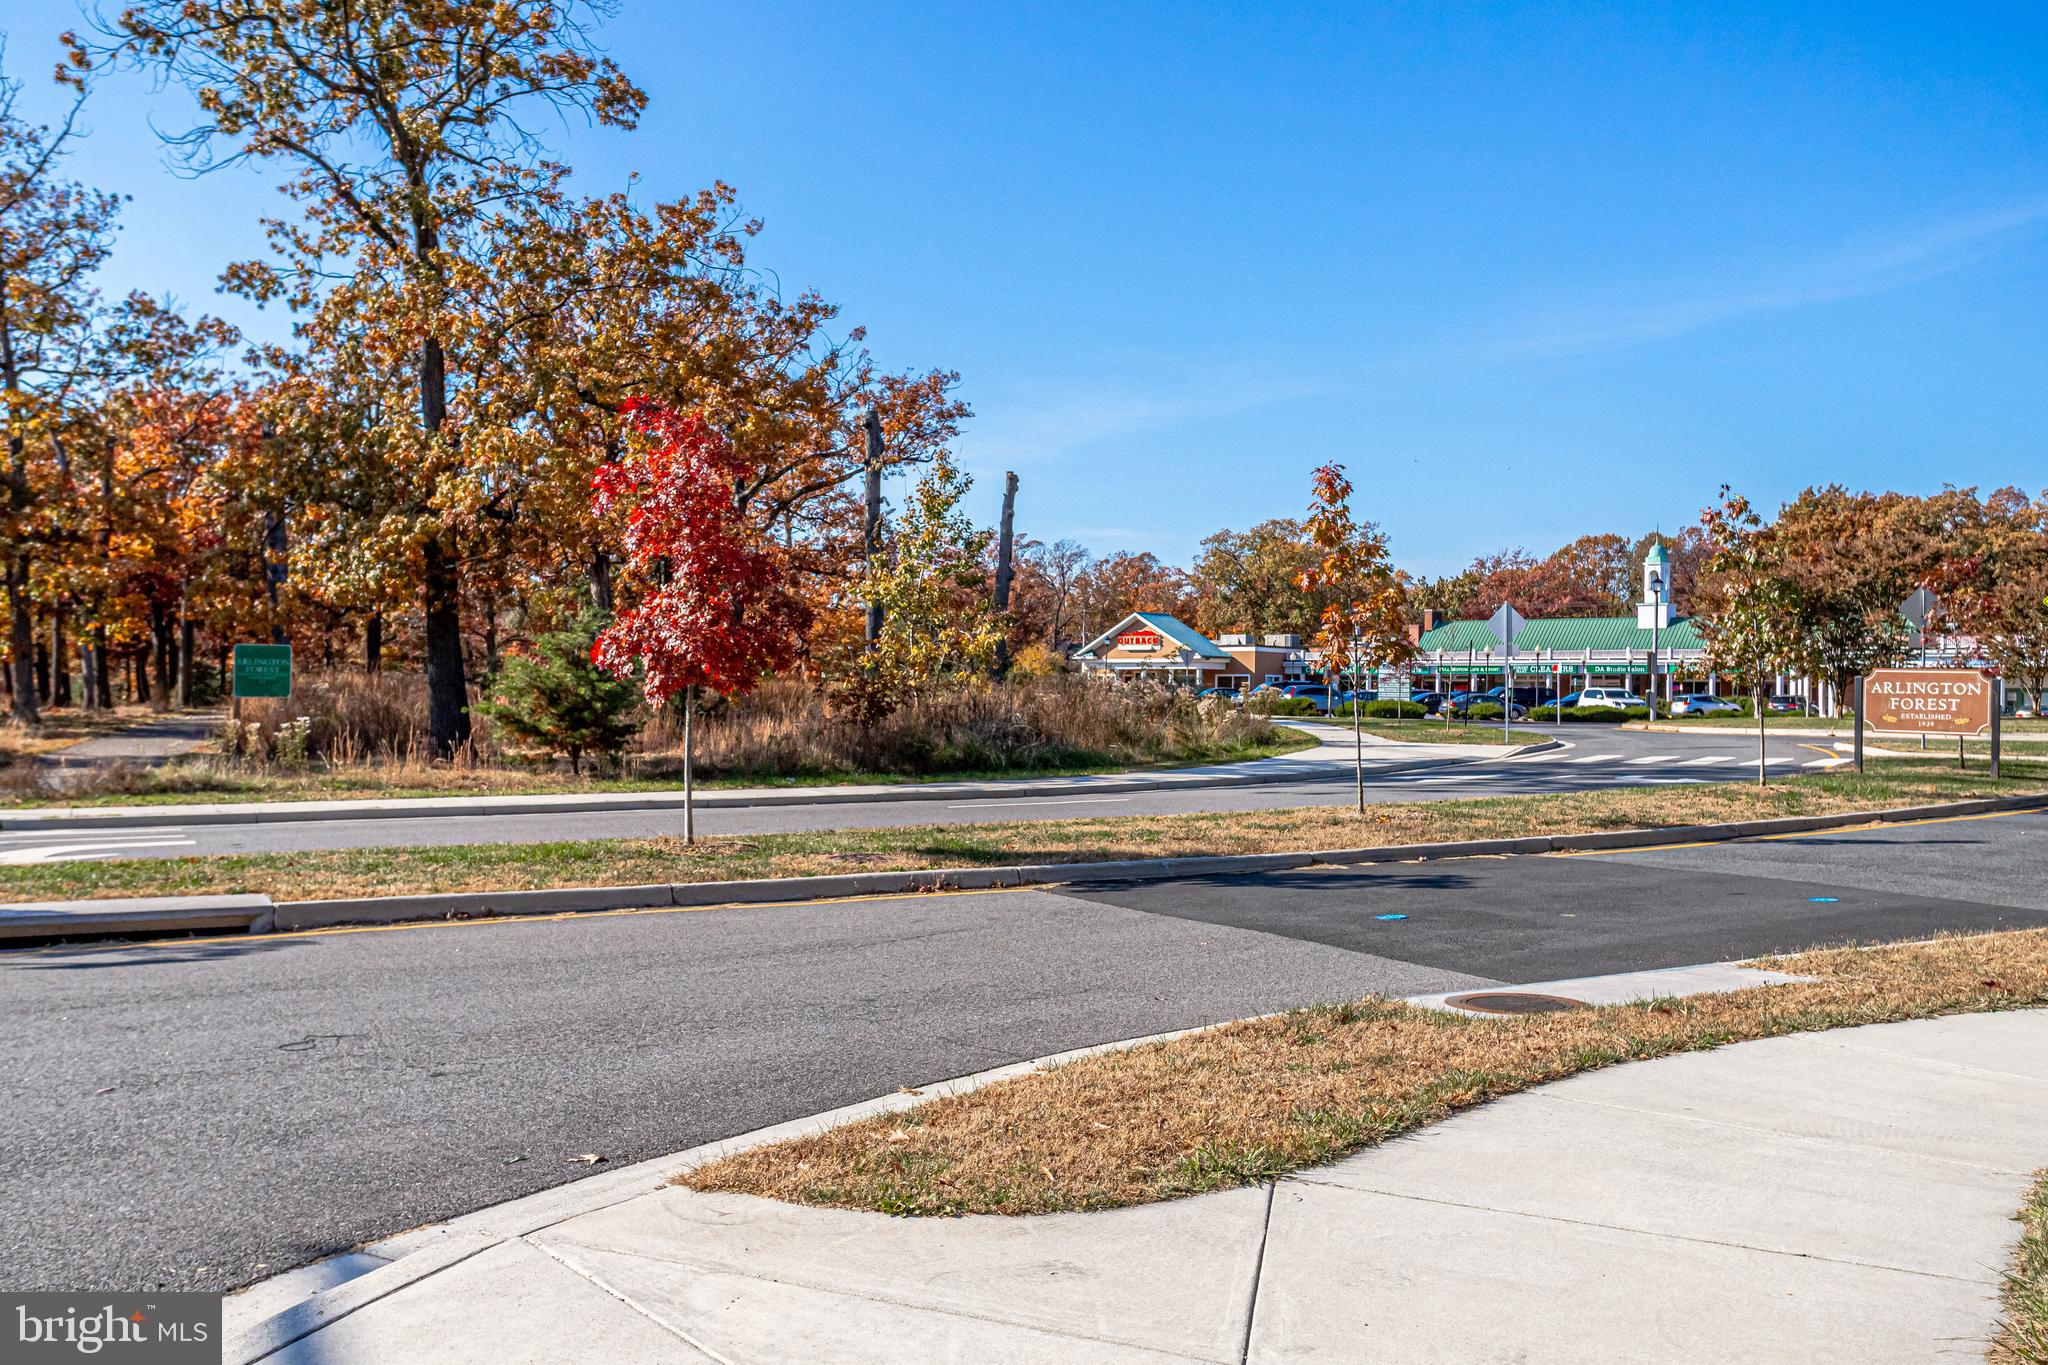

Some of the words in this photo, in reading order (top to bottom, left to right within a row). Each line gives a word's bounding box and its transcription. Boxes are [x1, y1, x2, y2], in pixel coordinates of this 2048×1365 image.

[1117, 637, 1159, 646] OUTBACK
[1871, 682, 1981, 696] ARLINGTON
[1890, 698, 1960, 711] FOREST
